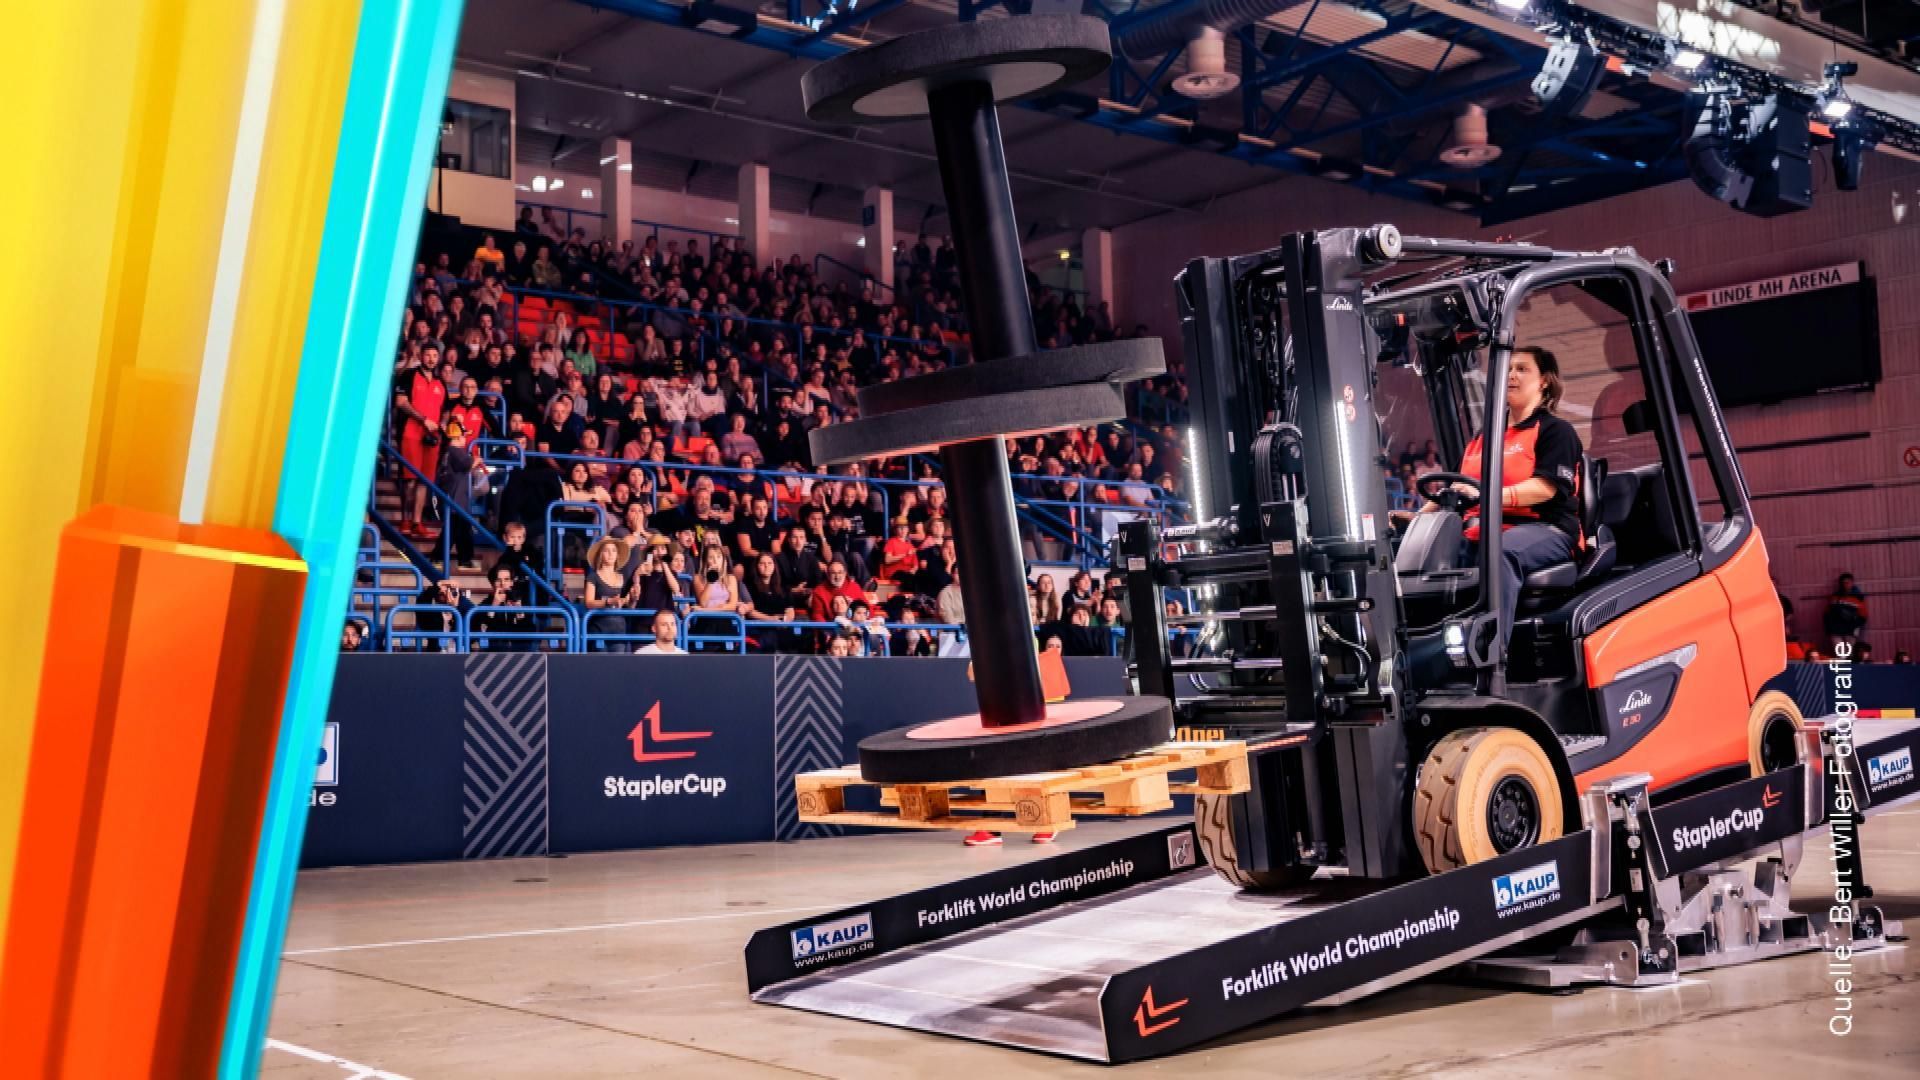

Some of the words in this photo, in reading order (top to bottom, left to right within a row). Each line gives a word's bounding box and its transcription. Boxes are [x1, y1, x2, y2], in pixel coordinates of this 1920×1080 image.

[1712, 287, 1753, 306] LINDE
[1758, 282, 1783, 298] MH
[1788, 269, 1842, 293] ARENA
[1325, 295, 1353, 311] Linde
[1619, 689, 1653, 713] Linde
[1882, 756, 1909, 776] KAUP
[604, 773, 727, 801] StaplerCup
[1673, 807, 1764, 852] StaplerCup
[917, 898, 976, 928] Forklift
[978, 884, 1026, 912] World
[1028, 857, 1134, 899] Championship
[1514, 873, 1555, 897] KAUP
[1497, 891, 1561, 918] www.kaup.de
[817, 923, 869, 947] KAUP
[794, 941, 875, 969] www.kaup.de
[1222, 960, 1288, 1000] Forklift
[1289, 942, 1343, 977] World
[1345, 905, 1460, 959] Championship
